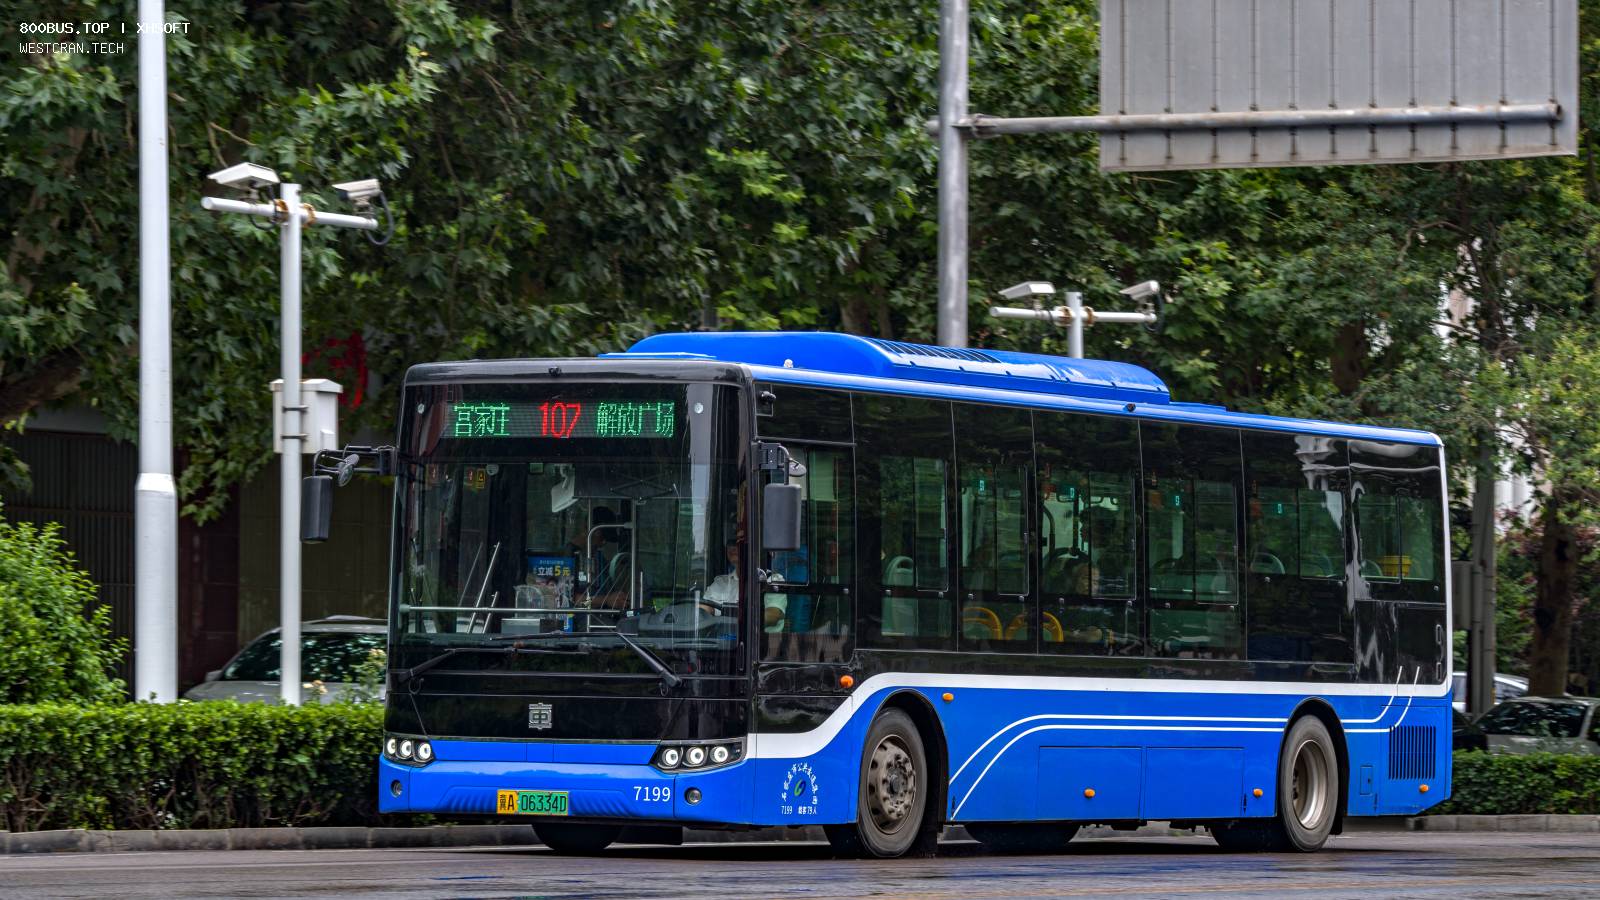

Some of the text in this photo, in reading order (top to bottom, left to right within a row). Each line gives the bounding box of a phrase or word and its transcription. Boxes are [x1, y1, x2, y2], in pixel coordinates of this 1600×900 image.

[453, 402, 675, 439] 宫家庄 107 解放广场
[633, 786, 671, 802] 7199
[780, 805, 793, 815] 7199
